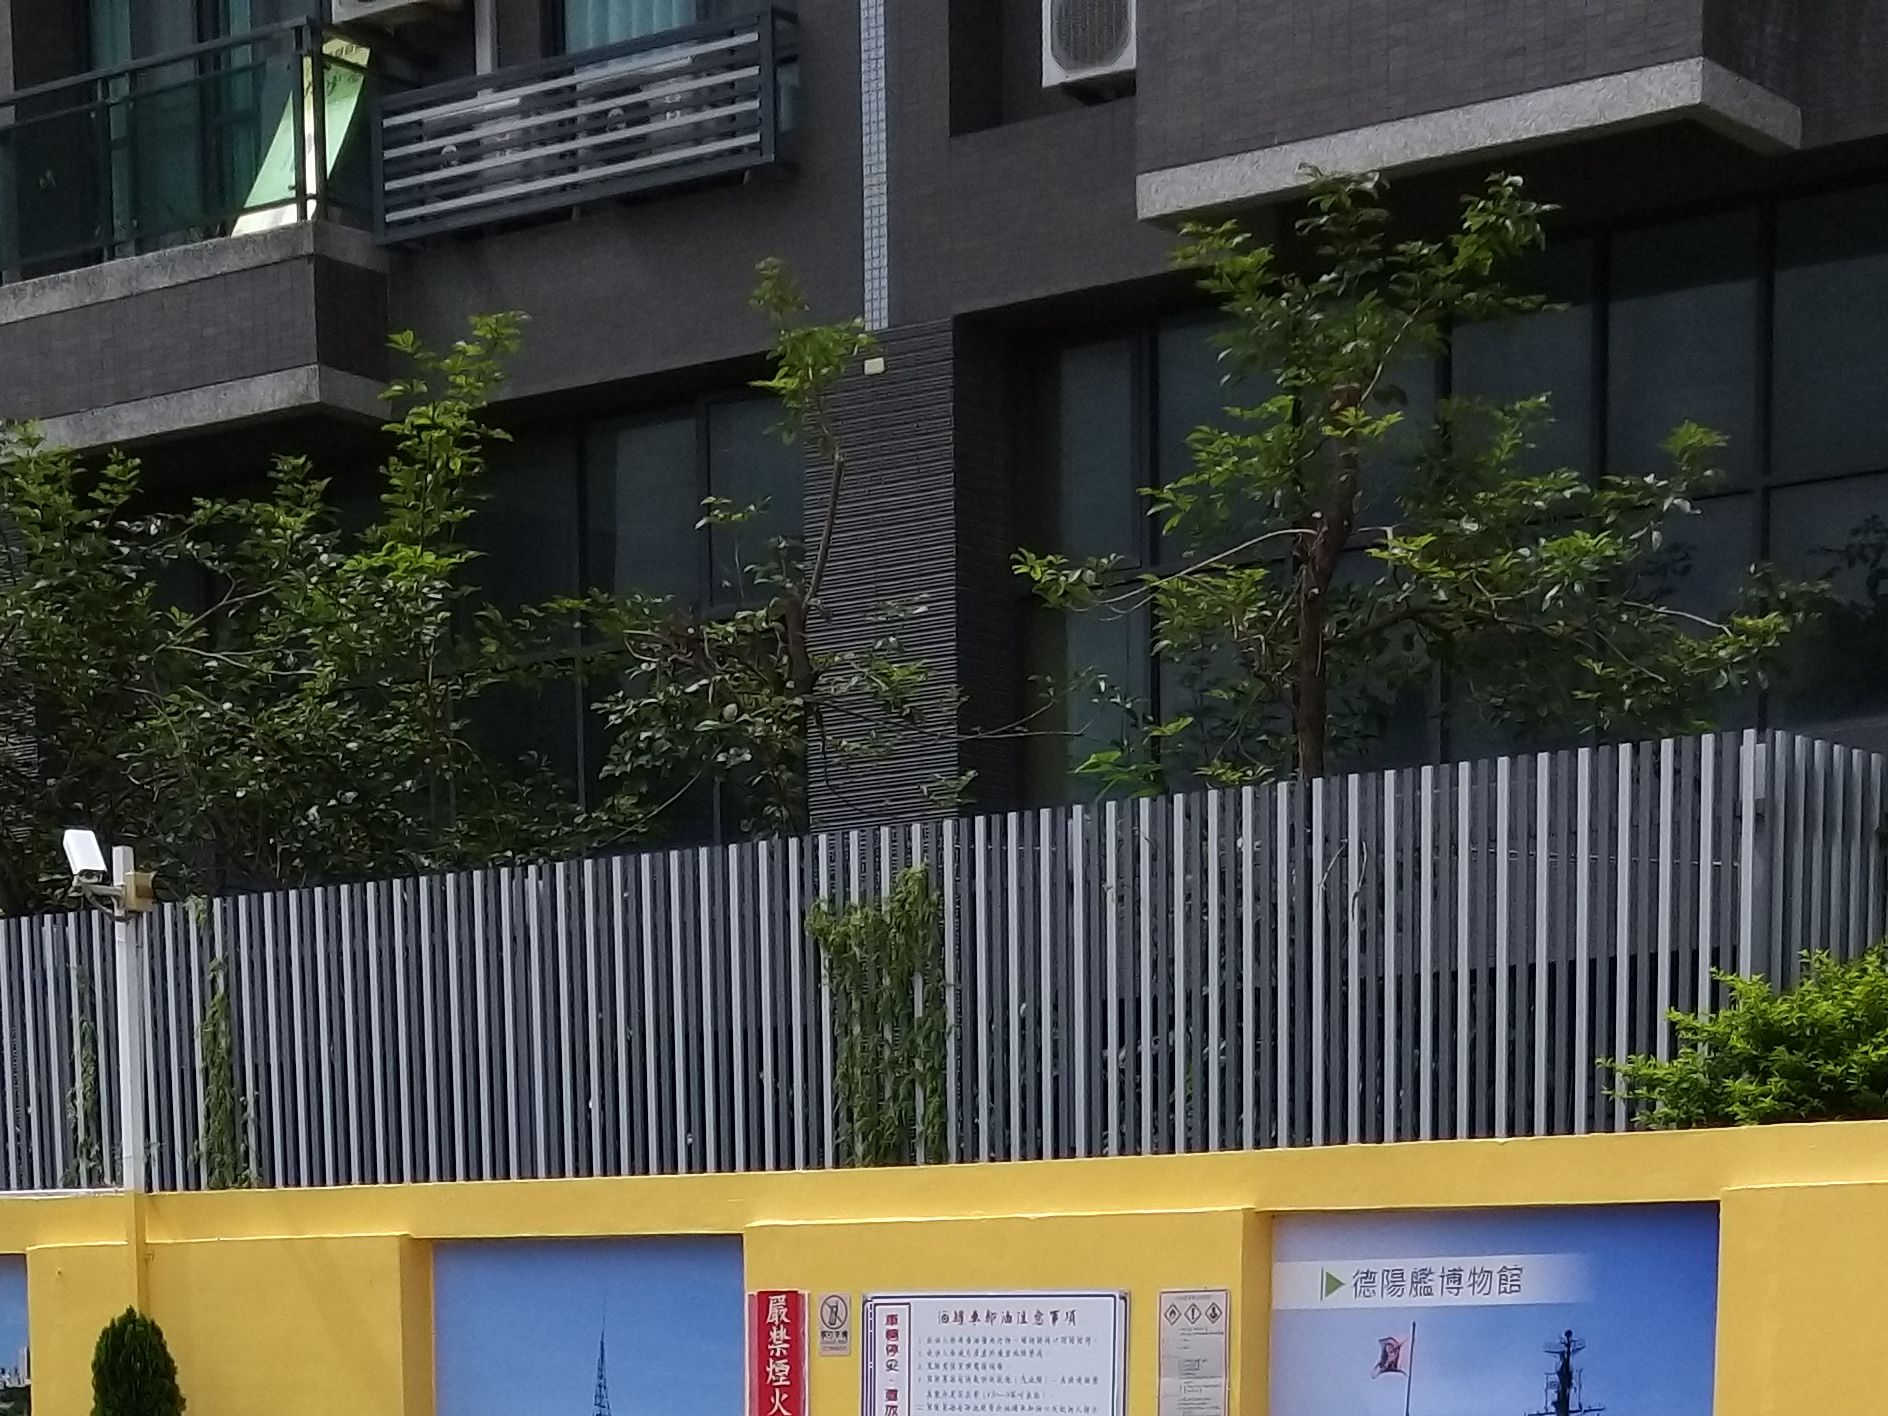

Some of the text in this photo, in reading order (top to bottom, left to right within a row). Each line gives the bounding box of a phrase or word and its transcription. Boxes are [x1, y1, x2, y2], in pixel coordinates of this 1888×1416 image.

[1352, 1265, 1524, 1299] 德陽艦博物館
[765, 1294, 792, 1416] 嚴禁煙火
